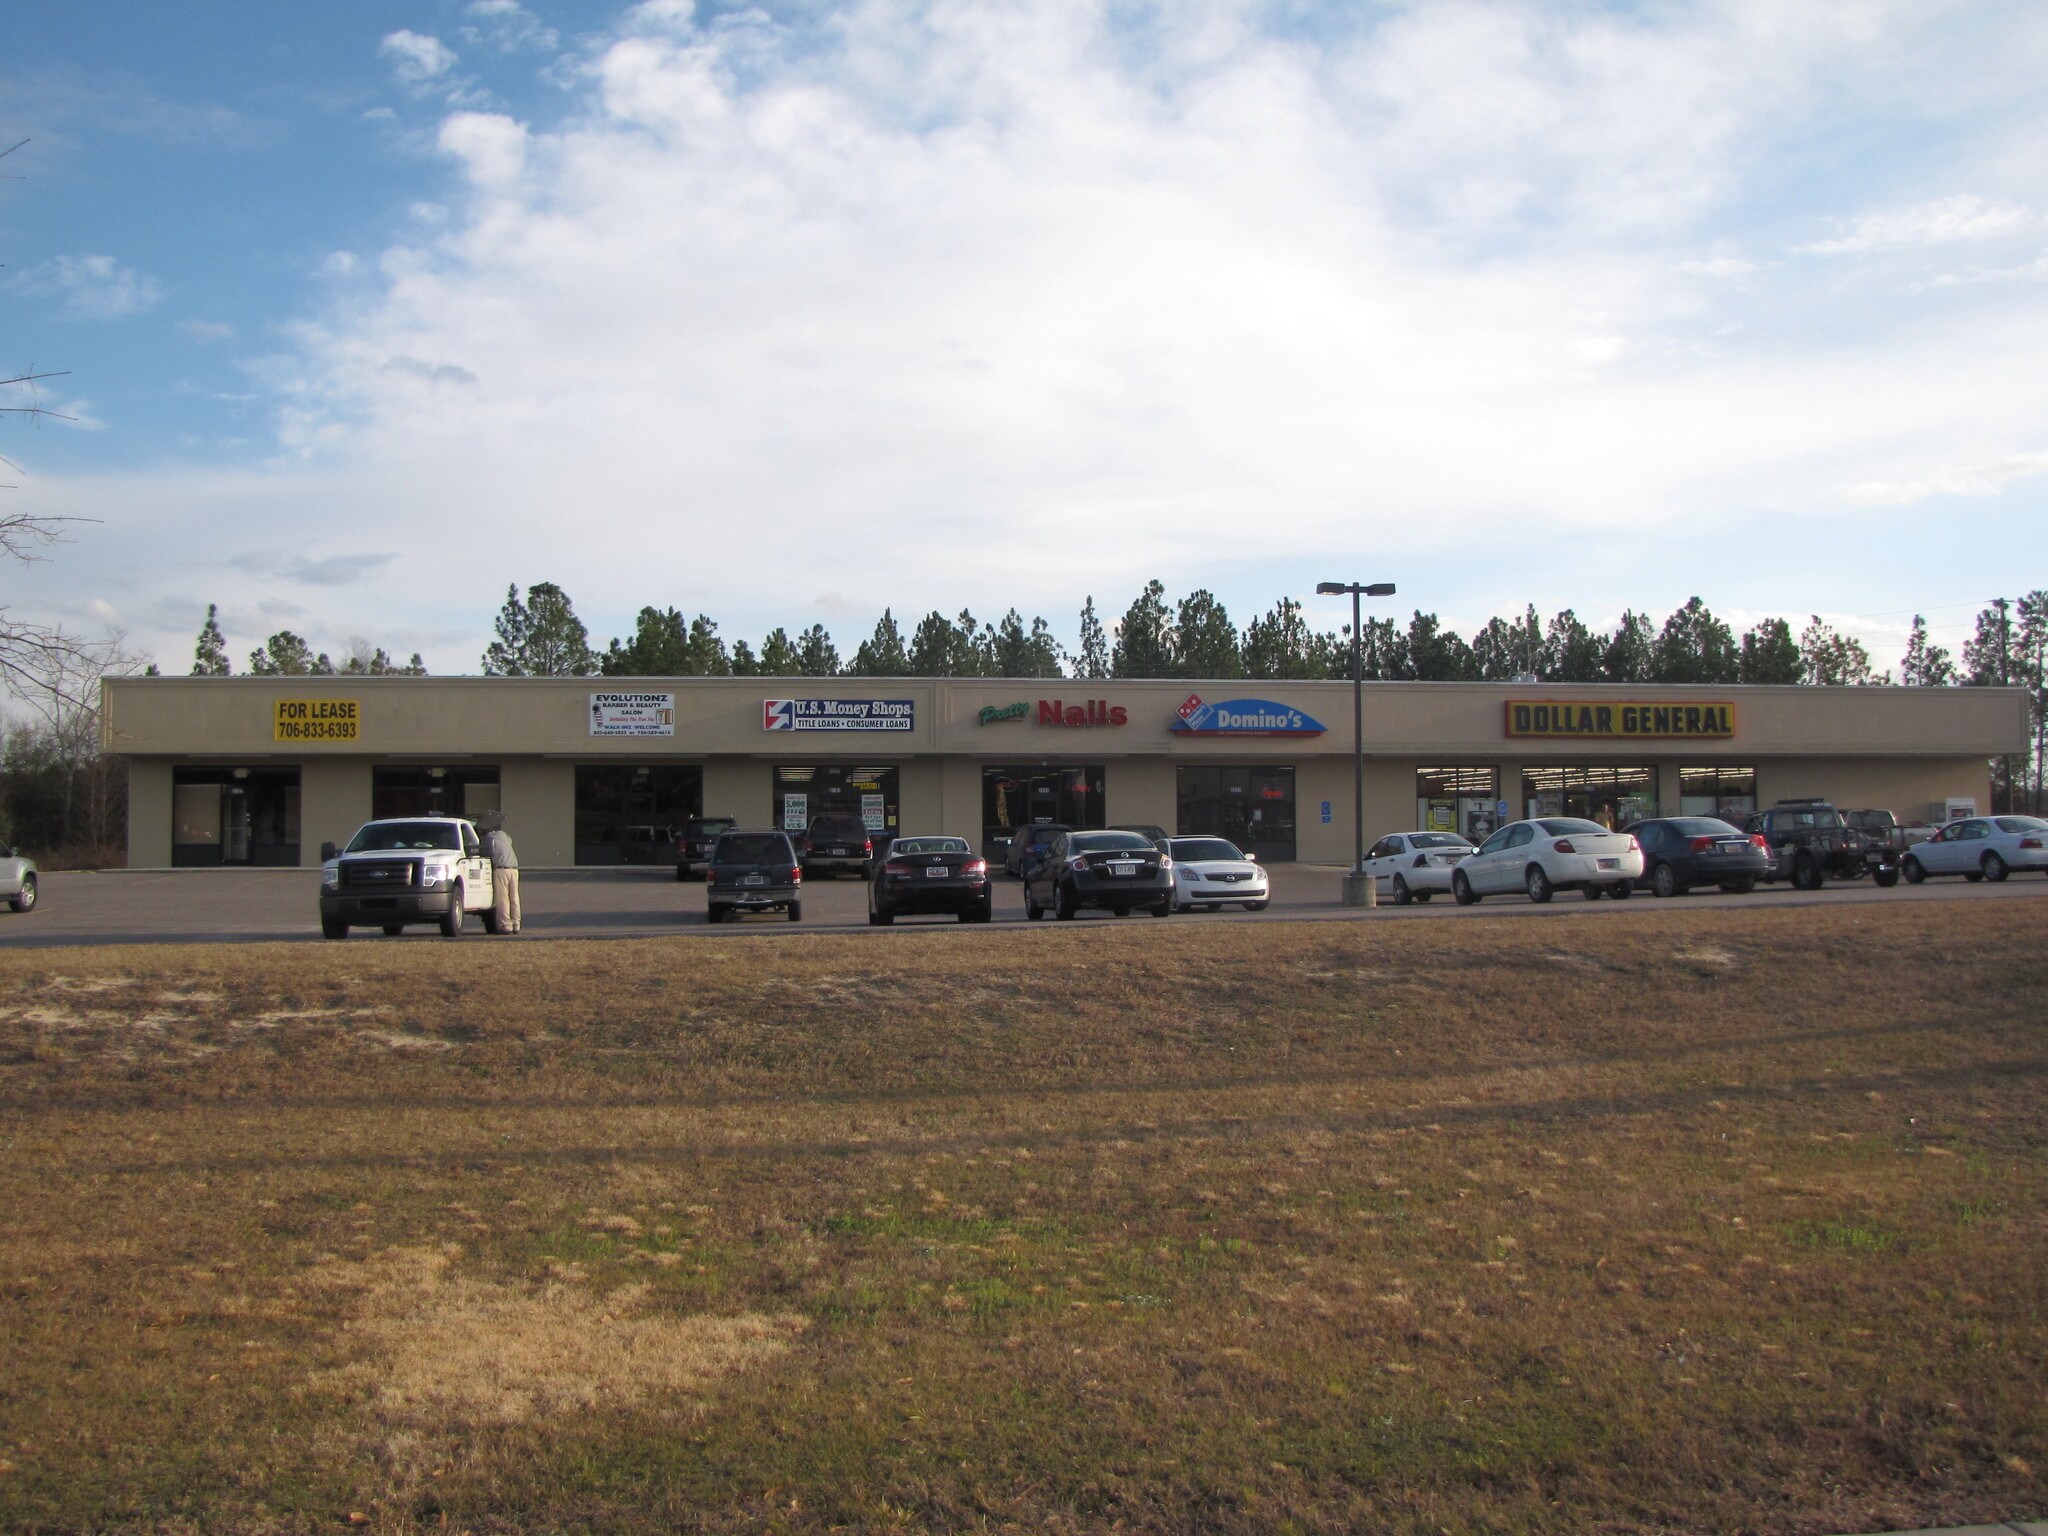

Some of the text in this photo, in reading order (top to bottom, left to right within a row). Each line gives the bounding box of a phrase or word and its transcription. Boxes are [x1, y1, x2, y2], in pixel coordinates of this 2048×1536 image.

[596, 694, 668, 702] EVOLUTIONZ
[279, 703, 356, 718] FOR LEASE
[795, 701, 912, 718] U.S. Money Shops
[979, 699, 1128, 727] Pretty Nails
[798, 719, 908, 728] TITLE LOANS CONSUMER LOANS
[1217, 709, 1302, 728] Domino's
[1514, 705, 1731, 733] DOLLAR GENERAL
[279, 722, 356, 737] 706-833-6393
